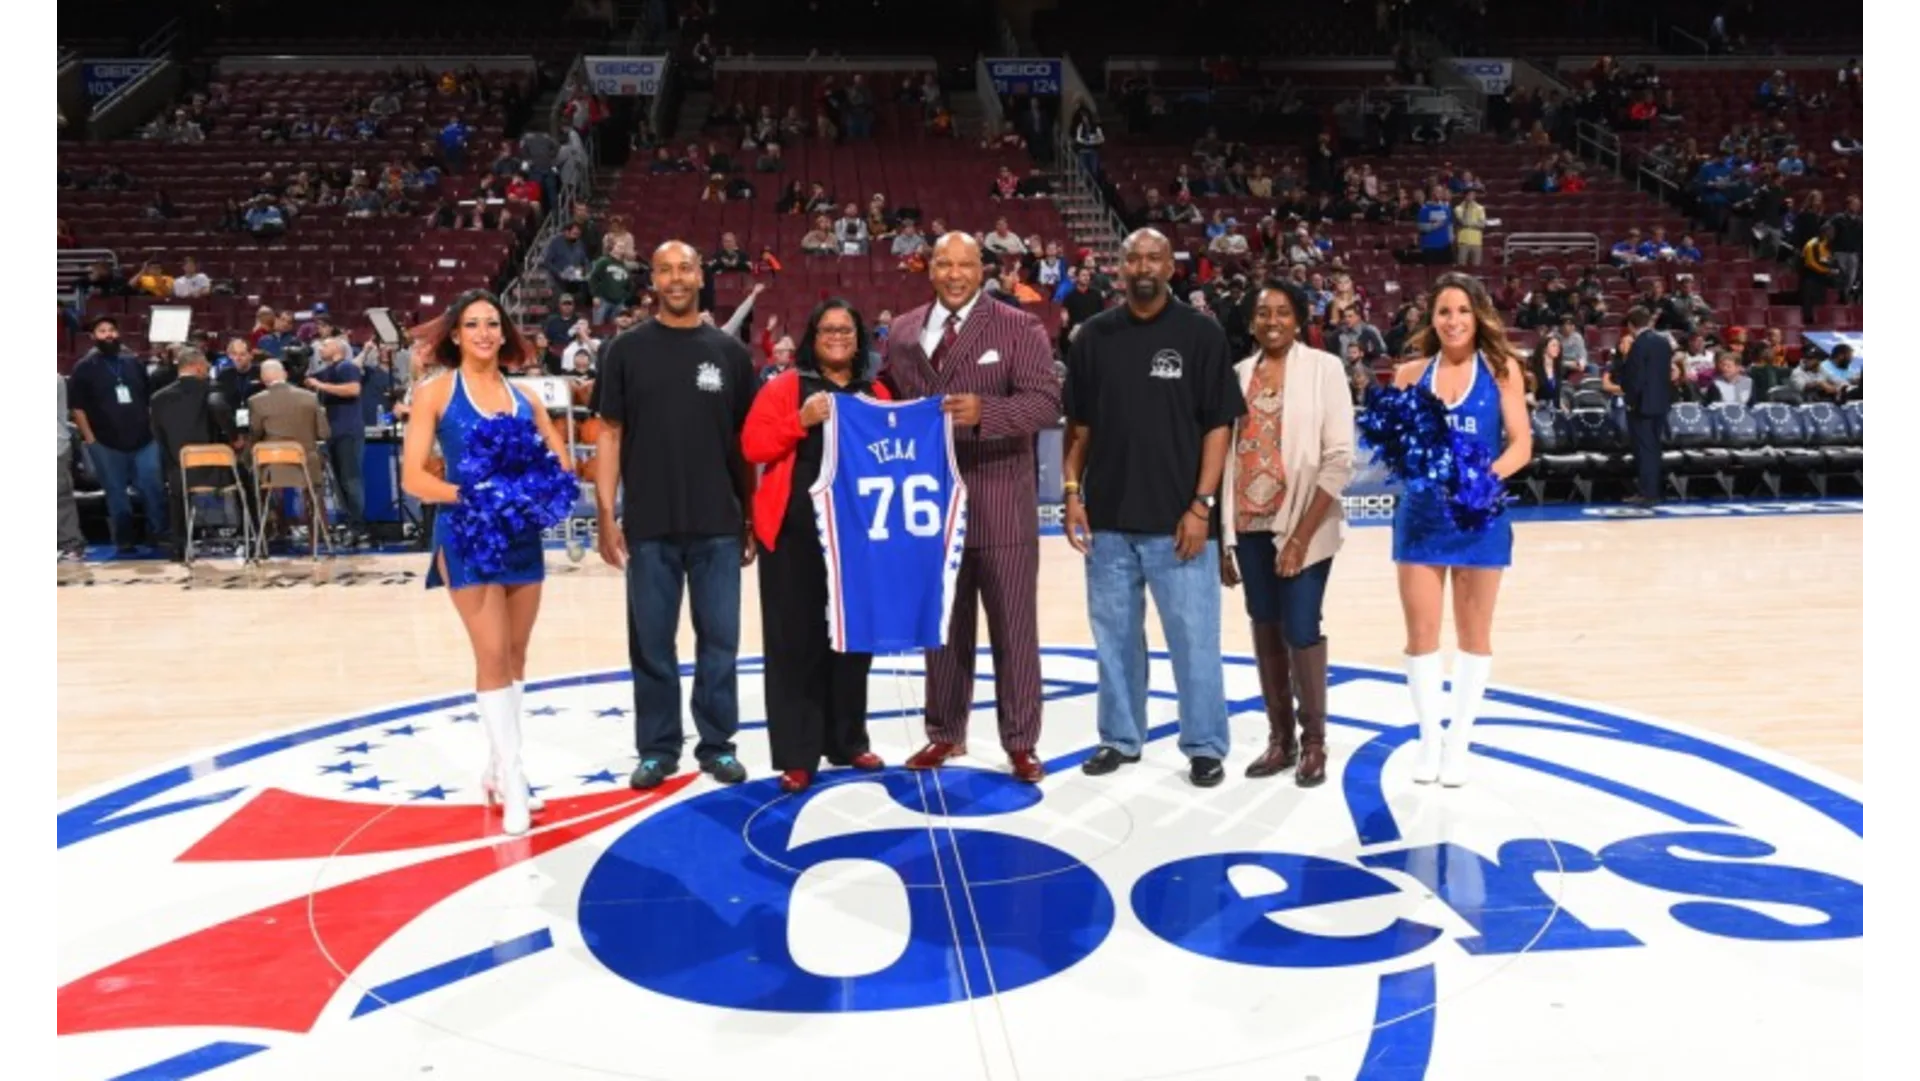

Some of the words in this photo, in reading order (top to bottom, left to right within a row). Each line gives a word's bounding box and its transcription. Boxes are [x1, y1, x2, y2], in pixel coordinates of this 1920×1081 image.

[595, 63, 653, 75] GEICO
[993, 64, 1051, 76] GEICO
[1033, 80, 1058, 93] 124
[866, 438, 915, 464] YEAA
[857, 474, 941, 541] 76
